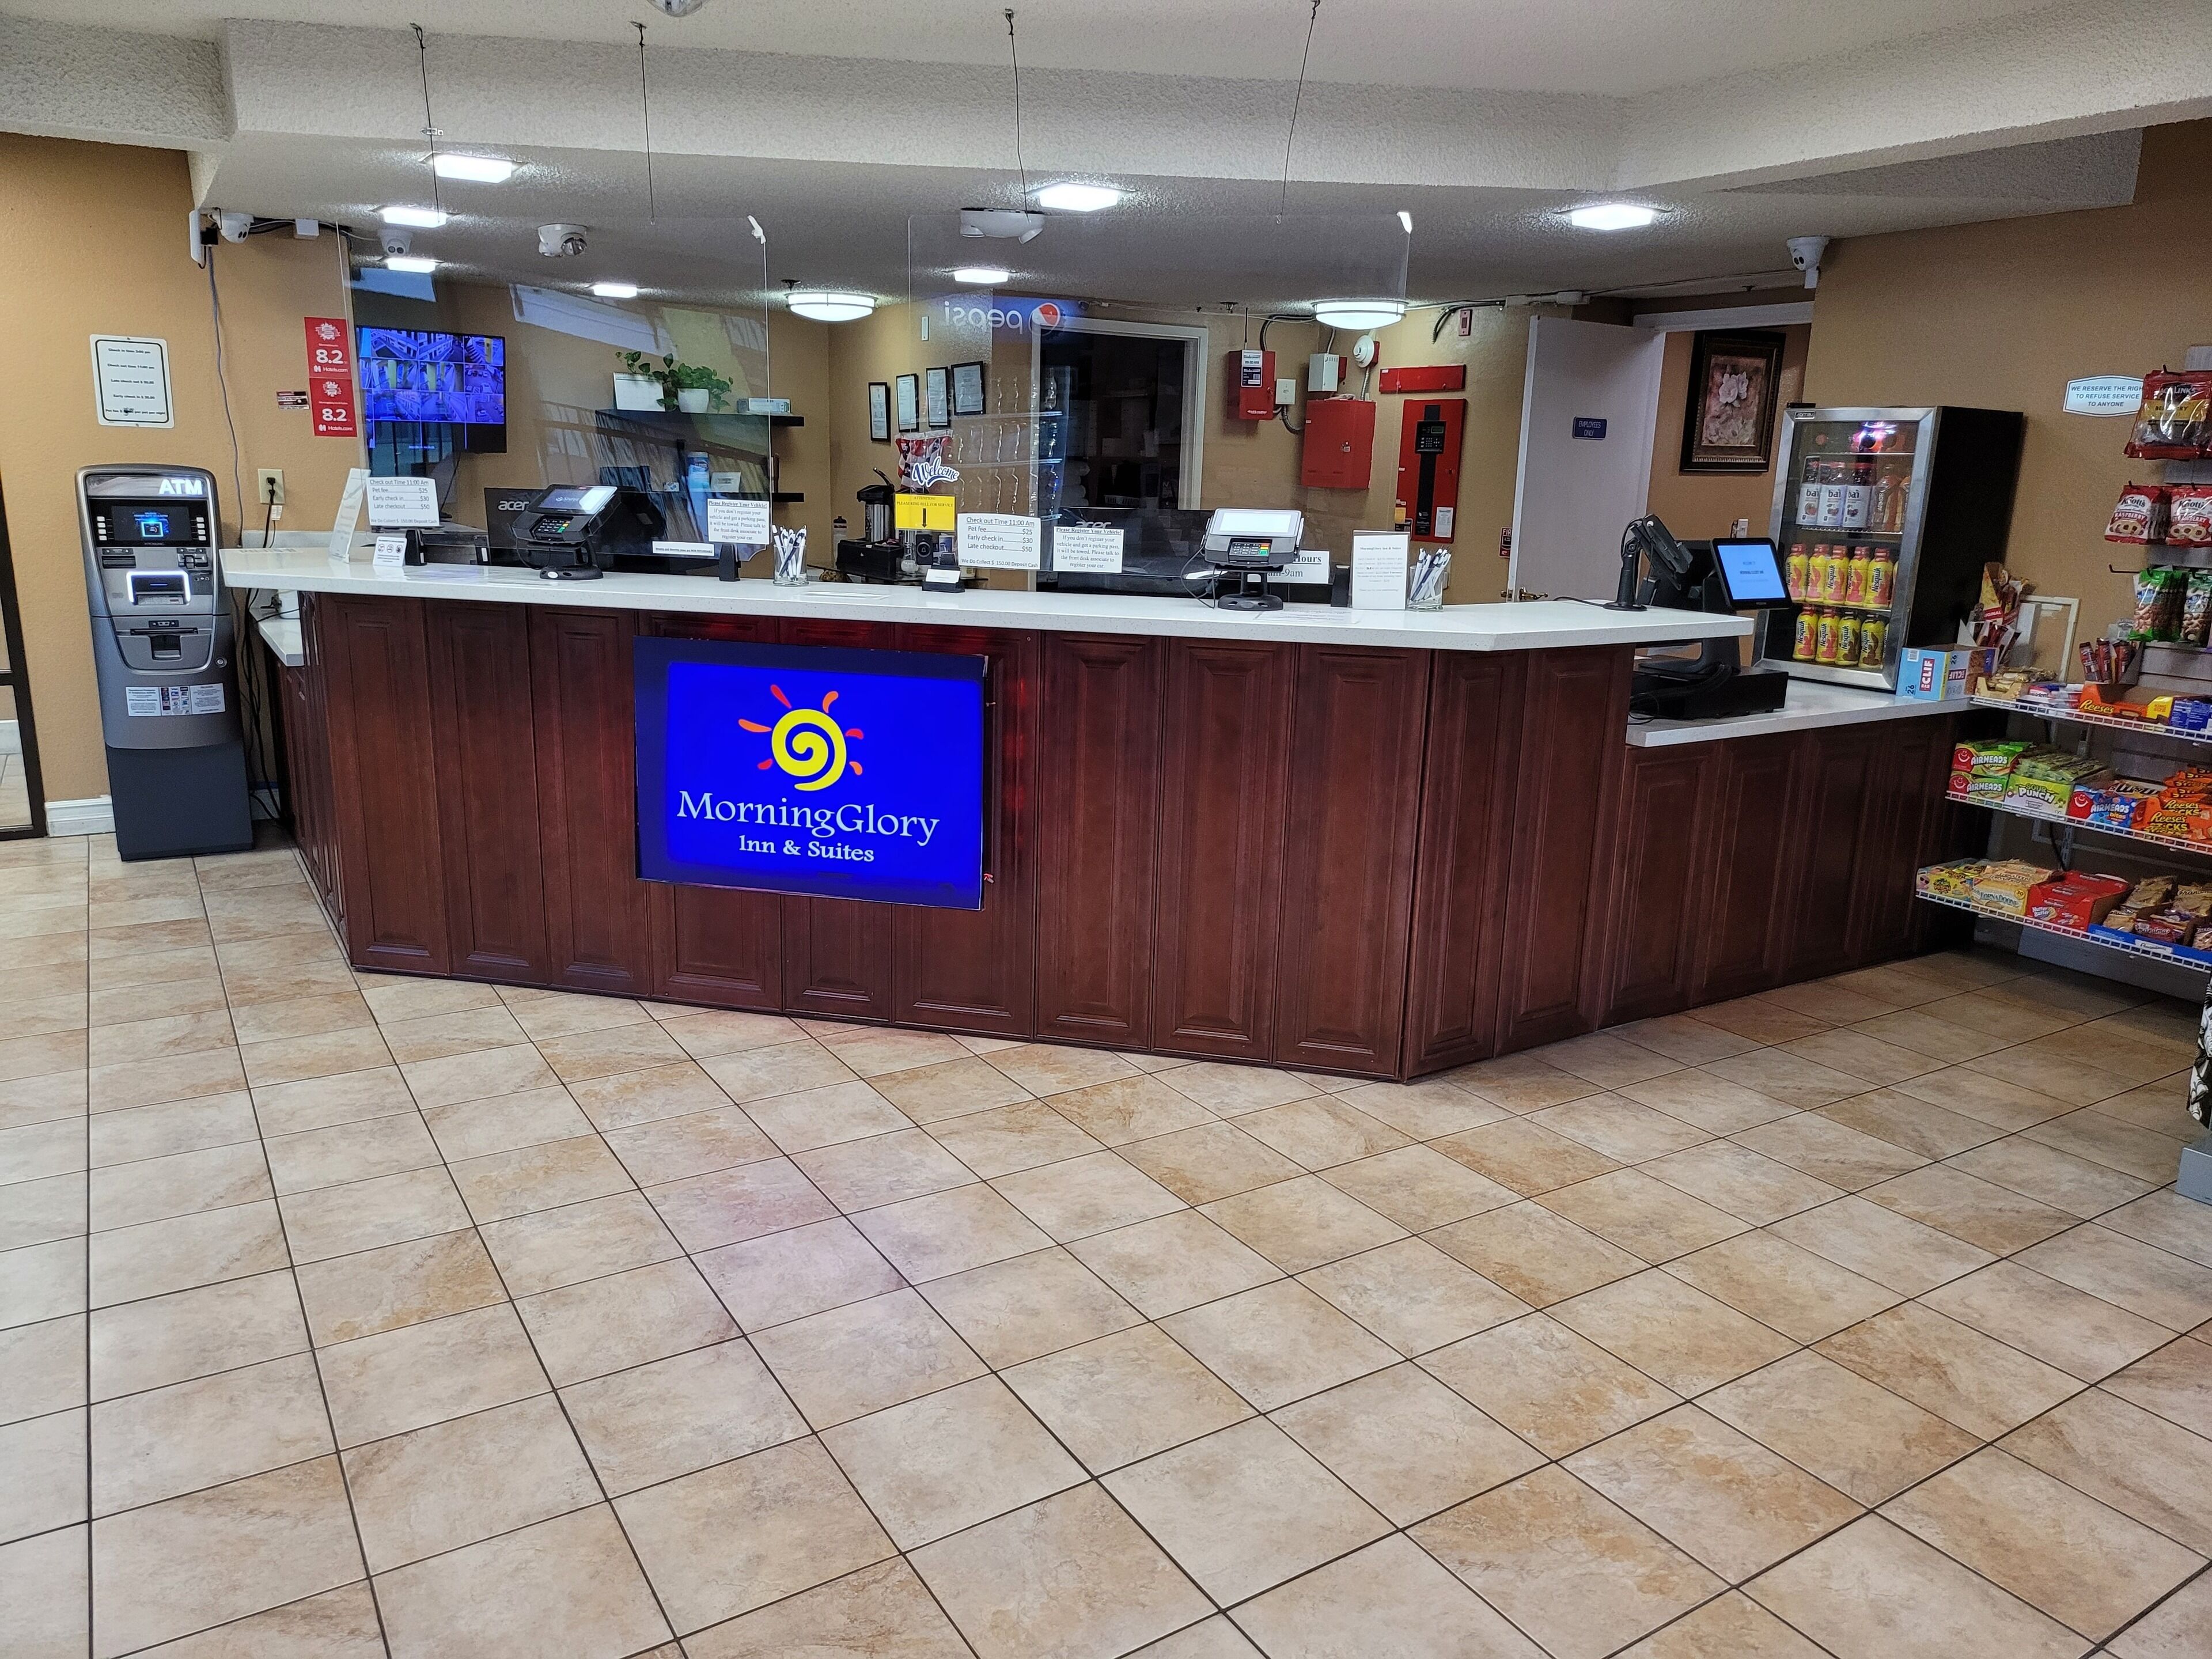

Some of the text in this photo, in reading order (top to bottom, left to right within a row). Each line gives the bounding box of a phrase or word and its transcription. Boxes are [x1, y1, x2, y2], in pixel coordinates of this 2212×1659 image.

[316, 349, 343, 364] 8.2
[322, 408, 347, 421] 8.2
[1578, 421, 1601, 429] EMPLOYEES
[912, 457, 959, 484] Welcome
[159, 479, 203, 495] ATM
[1828, 490, 1841, 498] bai
[498, 501, 529, 511] acer
[2115, 512, 2145, 520] RASPBERRY
[1872, 567, 1881, 593] Nesquik
[1951, 655, 1957, 665] 26
[1922, 661, 1933, 683] CLIF
[1907, 684, 1914, 694] 26
[2079, 699, 2115, 715] Reese's
[1971, 756, 2008, 765] AIRHEADS
[1966, 783, 2002, 793] AIRHEADS
[2025, 783, 2047, 793] SOUR
[2018, 787, 2055, 804] PUNCH
[2090, 804, 2130, 813] AIRHEADS
[676, 790, 940, 847] MorningGlory
[2151, 812, 2186, 823] Reese's
[739, 835, 874, 862] Inn & Suites
